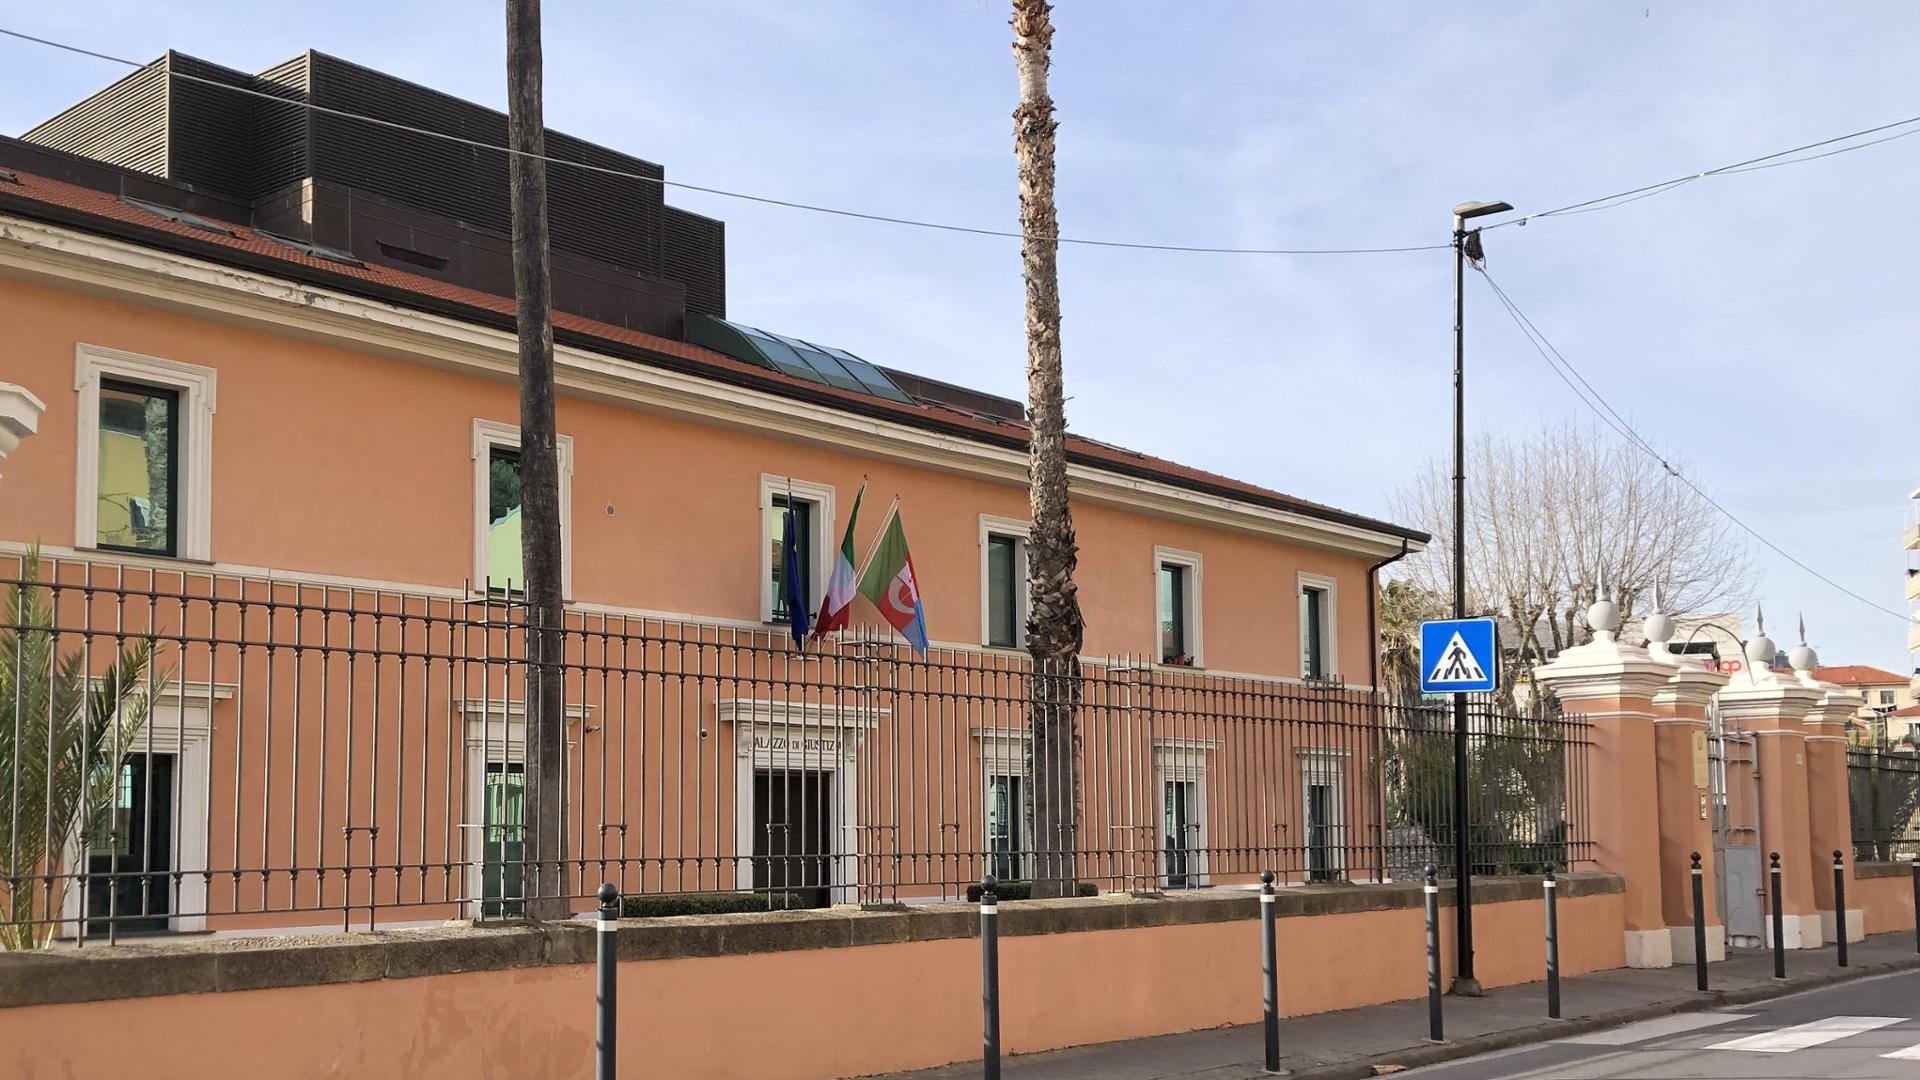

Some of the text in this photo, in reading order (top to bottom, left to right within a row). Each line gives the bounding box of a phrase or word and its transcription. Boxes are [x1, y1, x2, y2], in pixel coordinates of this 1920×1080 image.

[753, 737, 842, 751] ALAZZ DI IUSTIZA
